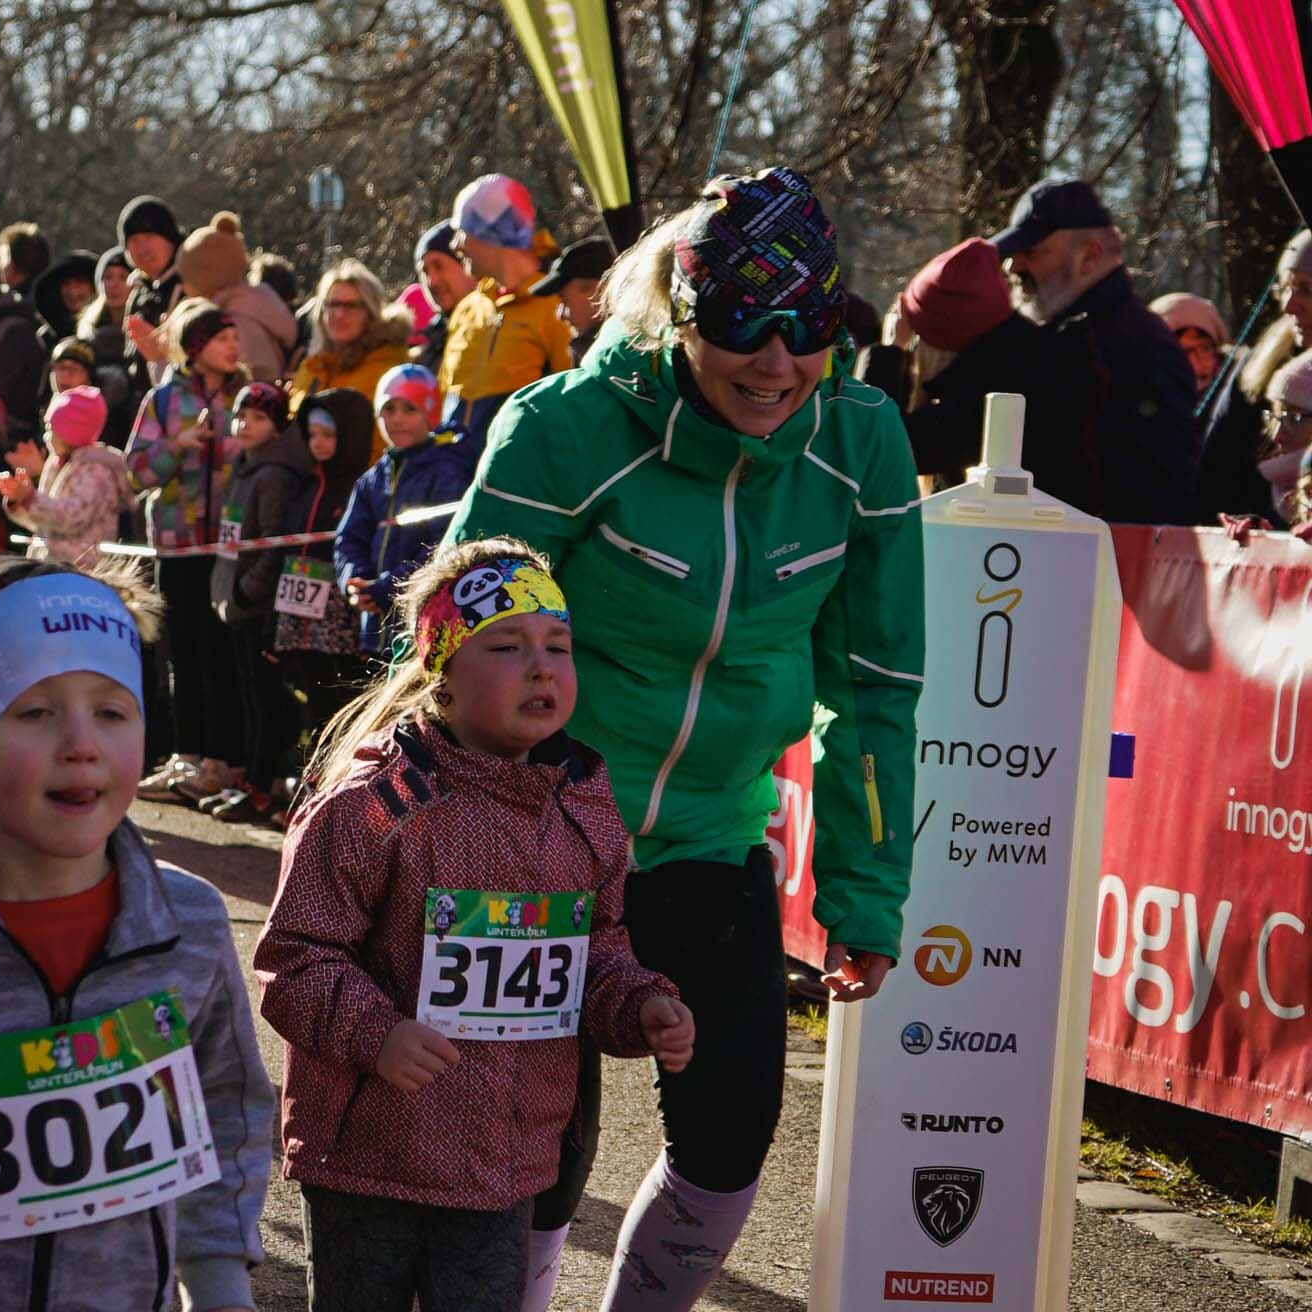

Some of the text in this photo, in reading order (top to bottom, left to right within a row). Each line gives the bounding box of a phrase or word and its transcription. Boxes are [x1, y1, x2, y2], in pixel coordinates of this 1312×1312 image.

[920, 739, 1058, 779] nnogy
[951, 812, 1051, 838] Powered
[948, 839, 1047, 868] by MVM
[983, 947, 1022, 968] NN
[429, 942, 572, 1008] 3143
[936, 1026, 1018, 1054] ŠKODA
[920, 1113, 1004, 1135] RUNTO
[920, 1172, 977, 1182] PEUGEOT
[891, 1278, 989, 1297] NUTREND
